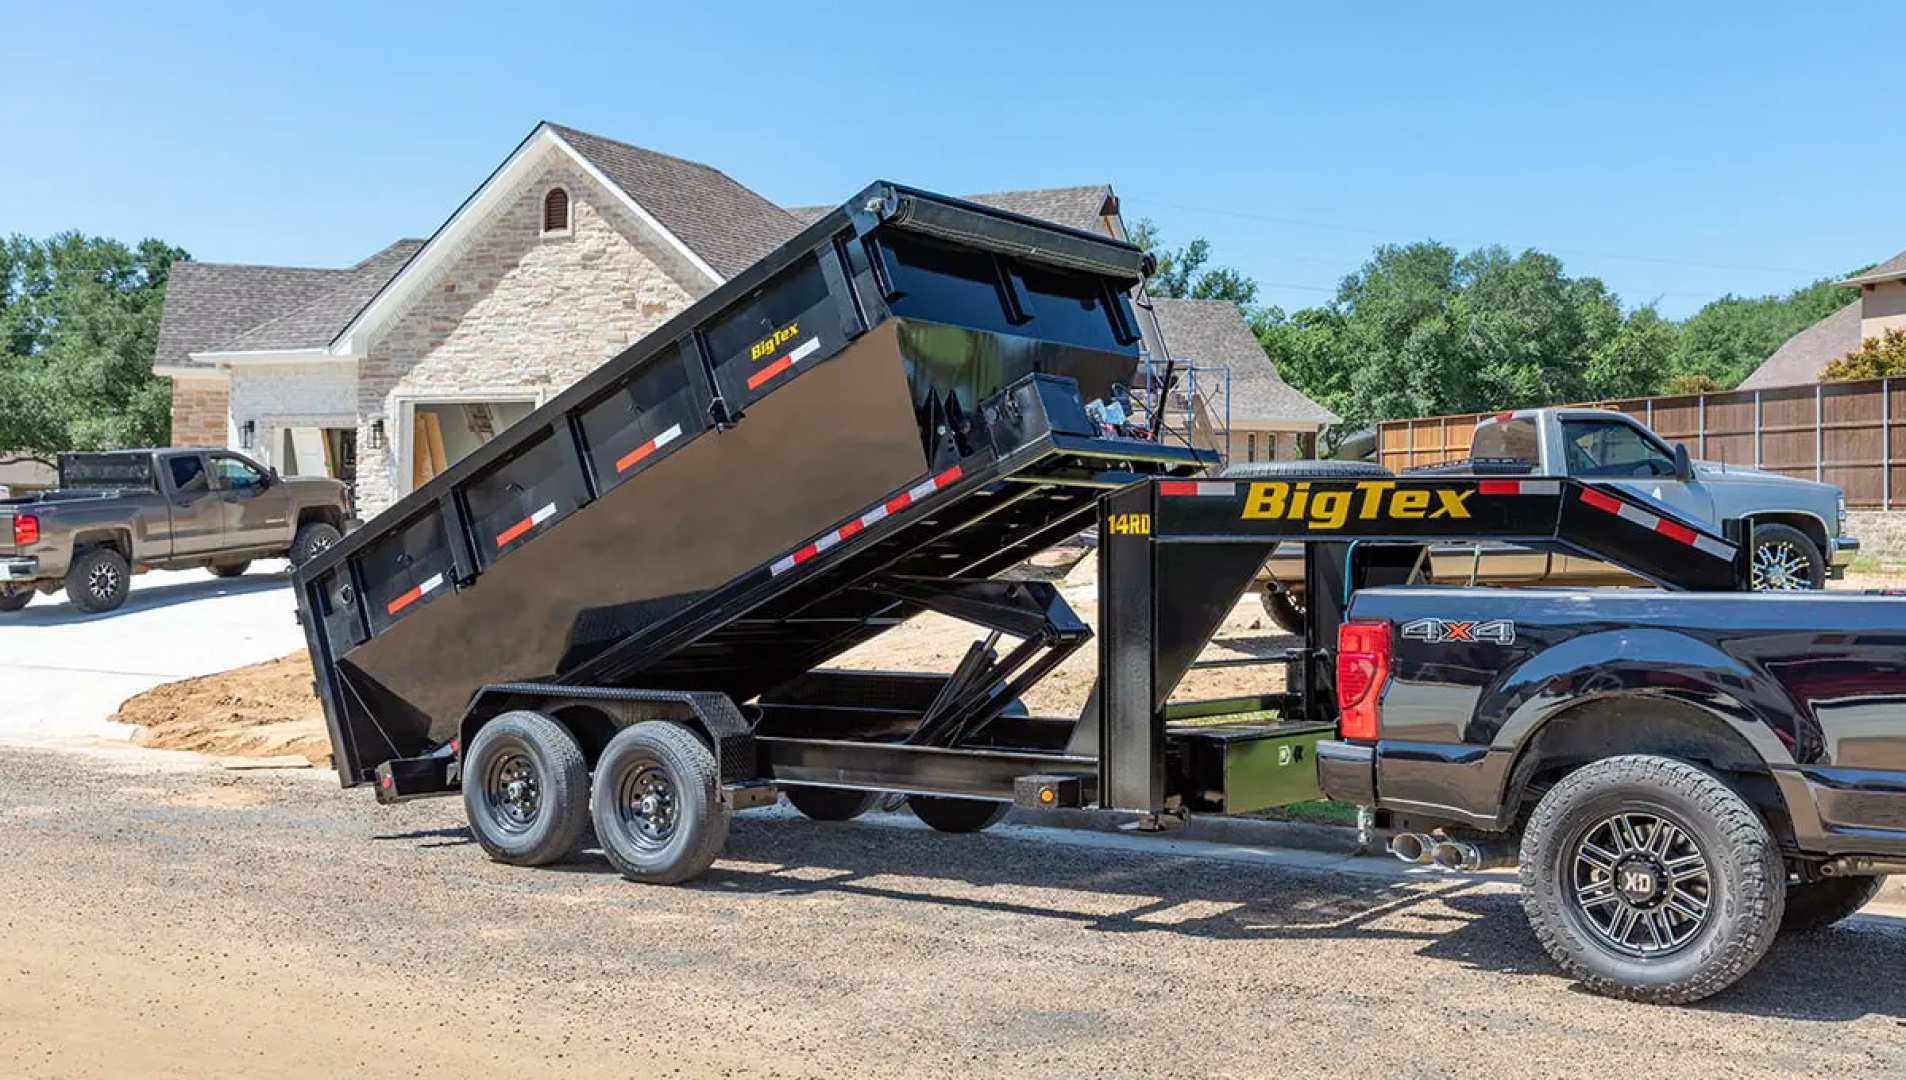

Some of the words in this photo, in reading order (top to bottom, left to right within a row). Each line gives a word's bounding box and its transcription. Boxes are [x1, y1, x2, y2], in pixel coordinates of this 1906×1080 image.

[750, 322, 800, 361] BigTex
[1241, 481, 1475, 530] BigTex
[1106, 512, 1151, 535] 14RD
[1624, 871, 1651, 892] XD
